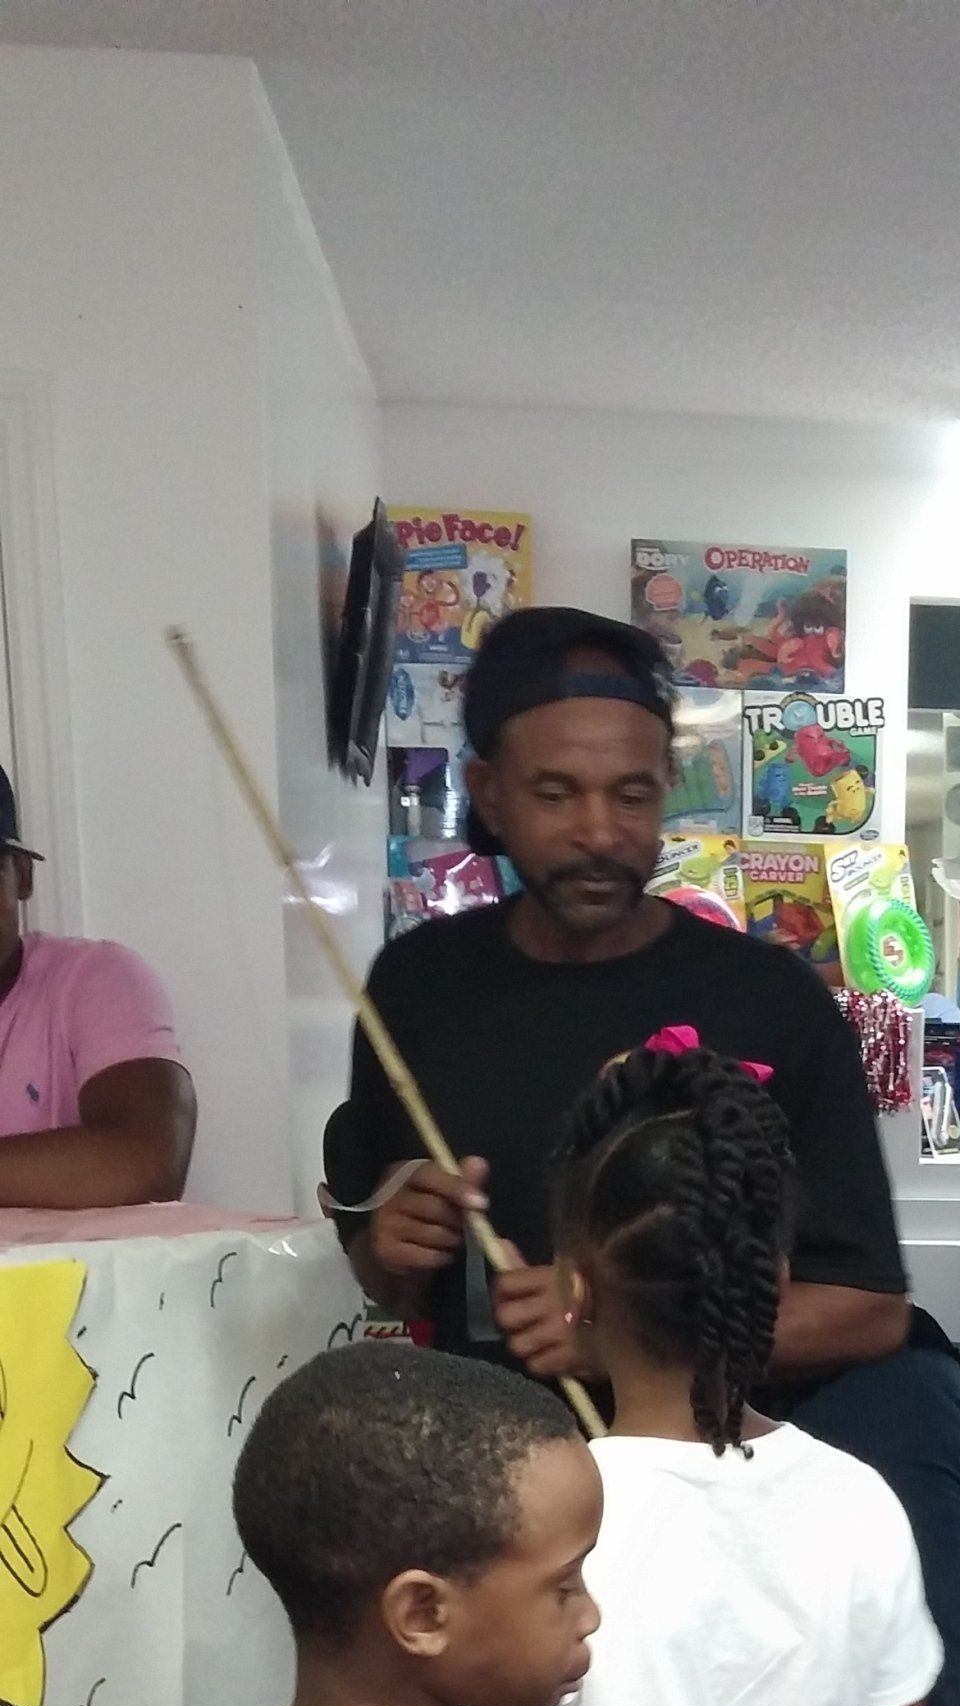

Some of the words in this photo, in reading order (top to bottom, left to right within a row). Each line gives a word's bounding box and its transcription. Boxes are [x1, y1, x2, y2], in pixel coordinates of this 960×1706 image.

[442, 514, 526, 551] Face!
[704, 547, 811, 575] OPERATION
[744, 697, 885, 735] TROUBLE
[739, 852, 820, 873] CRAYON
[750, 869, 805, 884] CARVER
